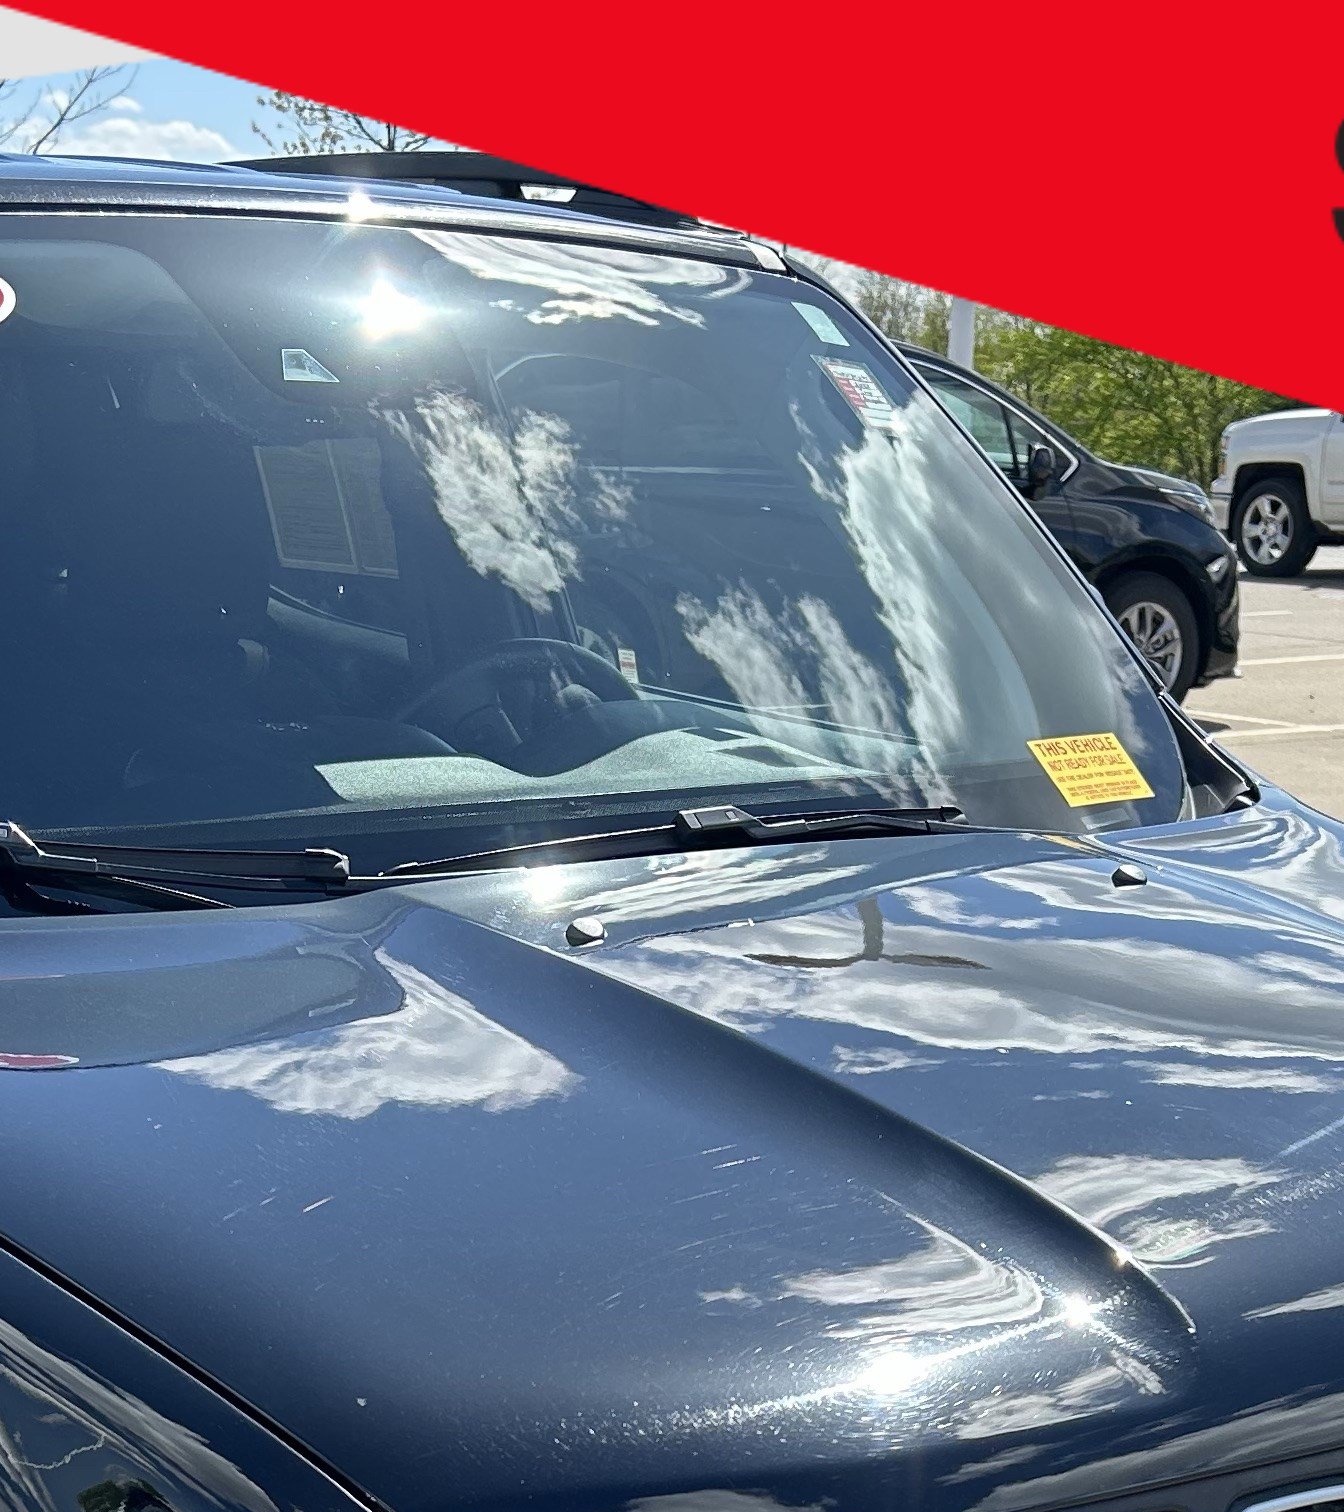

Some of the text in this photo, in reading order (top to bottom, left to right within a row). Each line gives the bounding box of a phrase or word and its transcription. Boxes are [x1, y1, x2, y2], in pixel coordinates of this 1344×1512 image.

[1034, 736, 1117, 757] THIS VEHICLE
[1047, 759, 1066, 772] NOT
